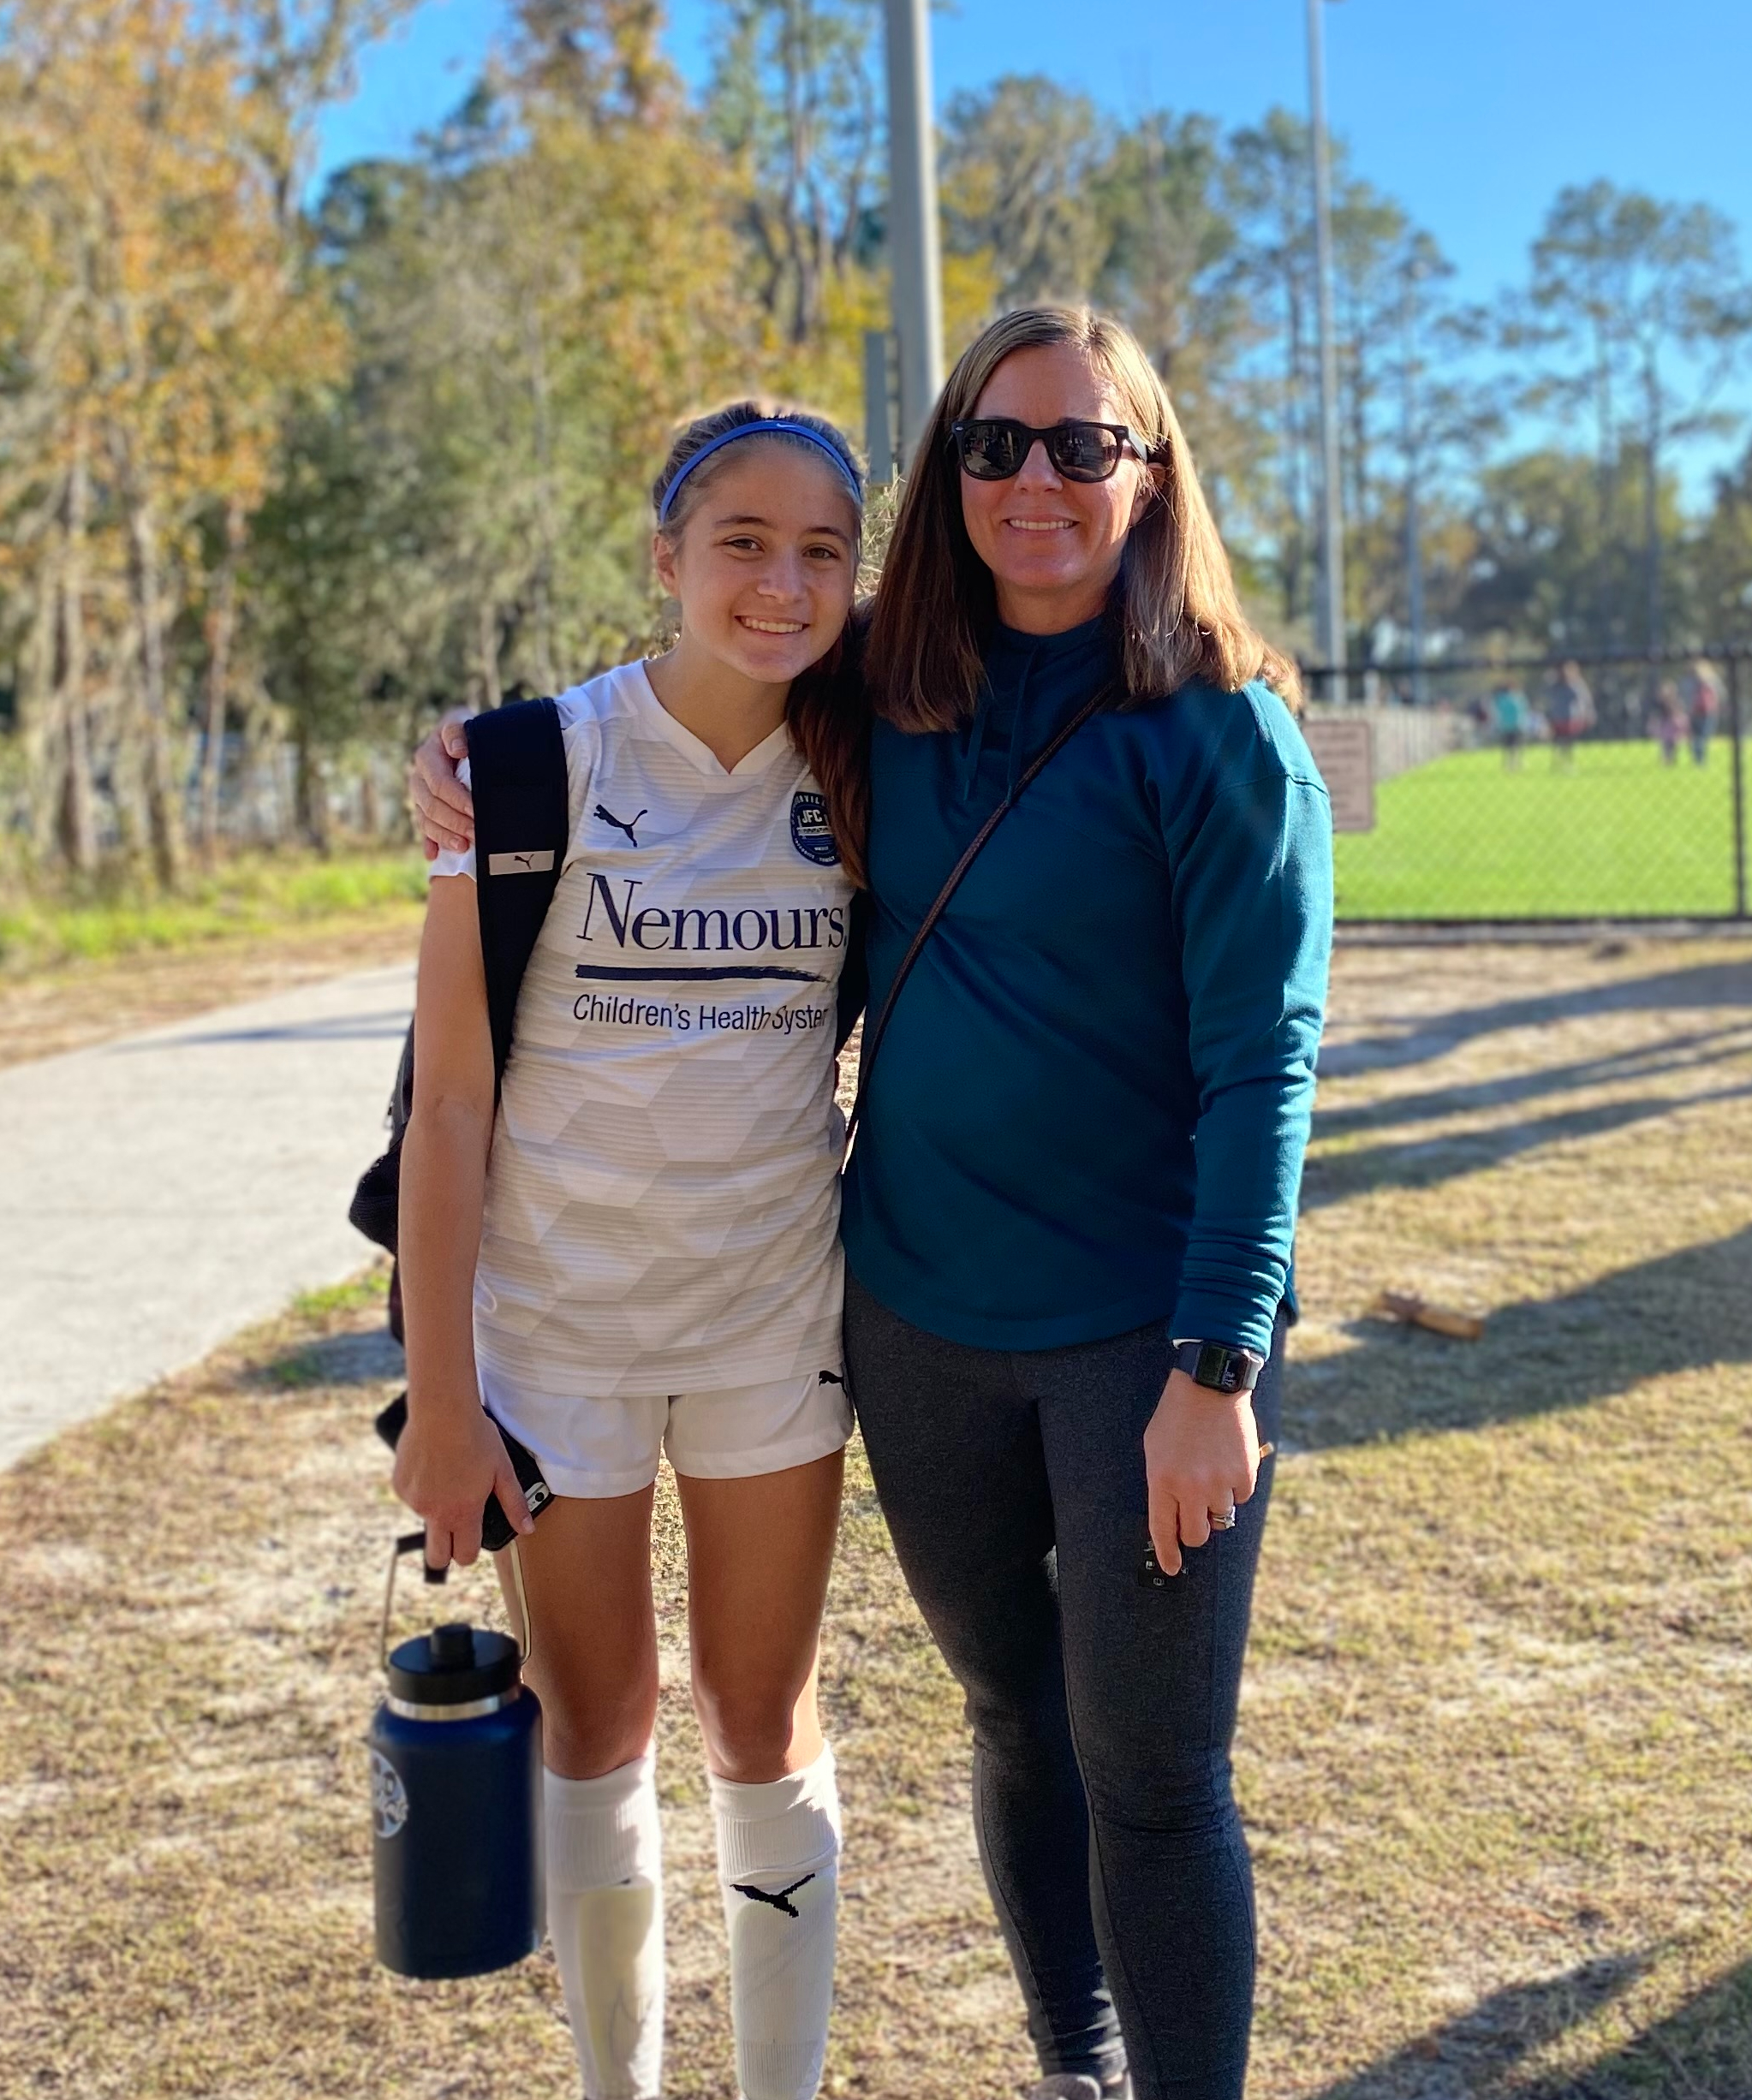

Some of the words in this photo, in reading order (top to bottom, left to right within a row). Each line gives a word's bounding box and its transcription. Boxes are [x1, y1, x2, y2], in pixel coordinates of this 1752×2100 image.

[802, 809, 823, 824] JFC
[574, 994, 690, 1030] Children's
[699, 1005, 771, 1030] Health
